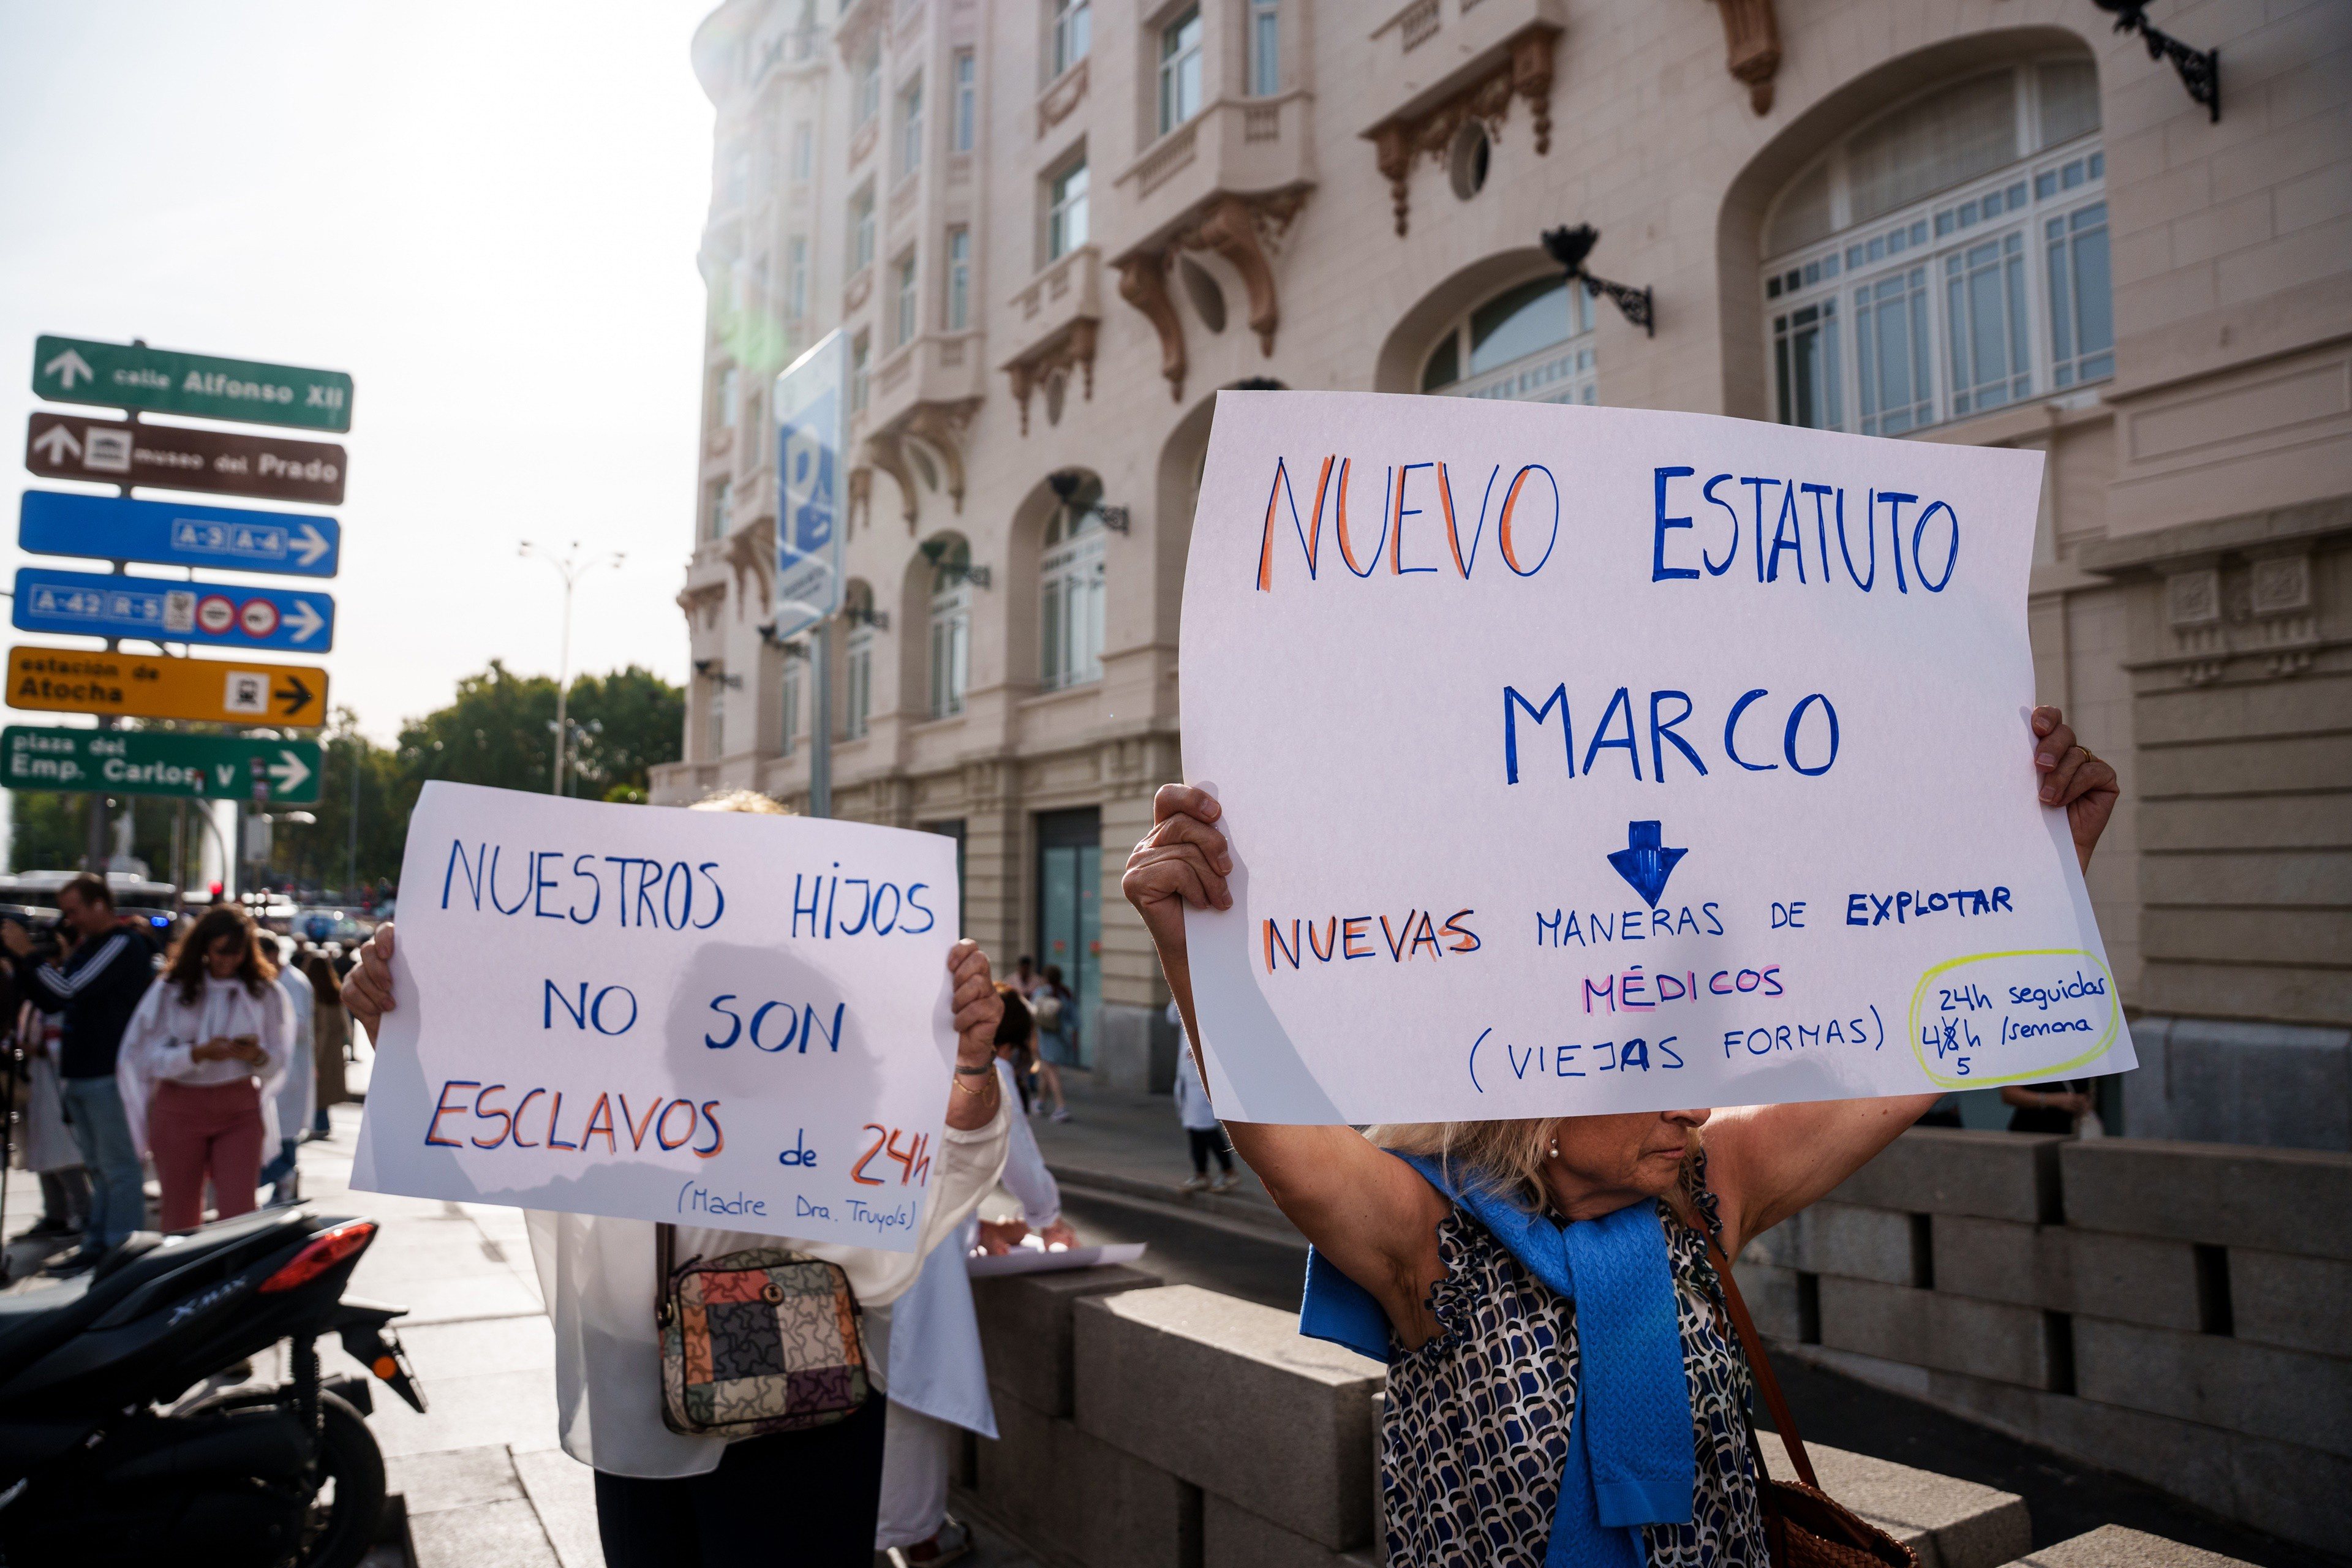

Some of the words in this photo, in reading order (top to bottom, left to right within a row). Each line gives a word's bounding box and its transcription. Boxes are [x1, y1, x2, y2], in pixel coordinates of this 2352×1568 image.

[114, 367, 172, 390] calle
[183, 370, 295, 405] Alfonso
[305, 383, 345, 410] XII
[213, 452, 248, 475] del
[257, 453, 339, 484] Prado
[178, 522, 225, 548] A-3
[236, 526, 281, 552] A-4
[1256, 453, 1559, 592] NUEVO
[1651, 466, 1959, 595] ESTATUTO
[18, 677, 124, 703] Atocha
[133, 663, 160, 681] de
[12, 733, 76, 753] plaza
[88, 736, 126, 756] del
[1503, 682, 1840, 785] MARCO
[11, 752, 86, 783] Emp.
[214, 763, 236, 788] V
[442, 839, 725, 930] NUESTROS
[1262, 908, 1481, 974] NUEVAS
[1536, 901, 1724, 948] MANERAS
[1771, 901, 1807, 929] DE
[1846, 886, 2013, 927] EXPLOTAR
[1582, 965, 1784, 1013] MÉDICOS
[1939, 983, 1992, 1011] 24h
[2008, 970, 2105, 1011] seguidas
[544, 979, 638, 1036] NO
[705, 994, 845, 1054] SON
[1724, 1004, 1884, 1059] FORMAS)
[1957, 1057, 1971, 1076] 5
[424, 1080, 723, 1159] ESCLAVOS
[778, 1128, 816, 1167] de
[851, 1123, 930, 1186] 24h
[678, 1180, 767, 1216] (Madre
[796, 1195, 839, 1223] Dra.
